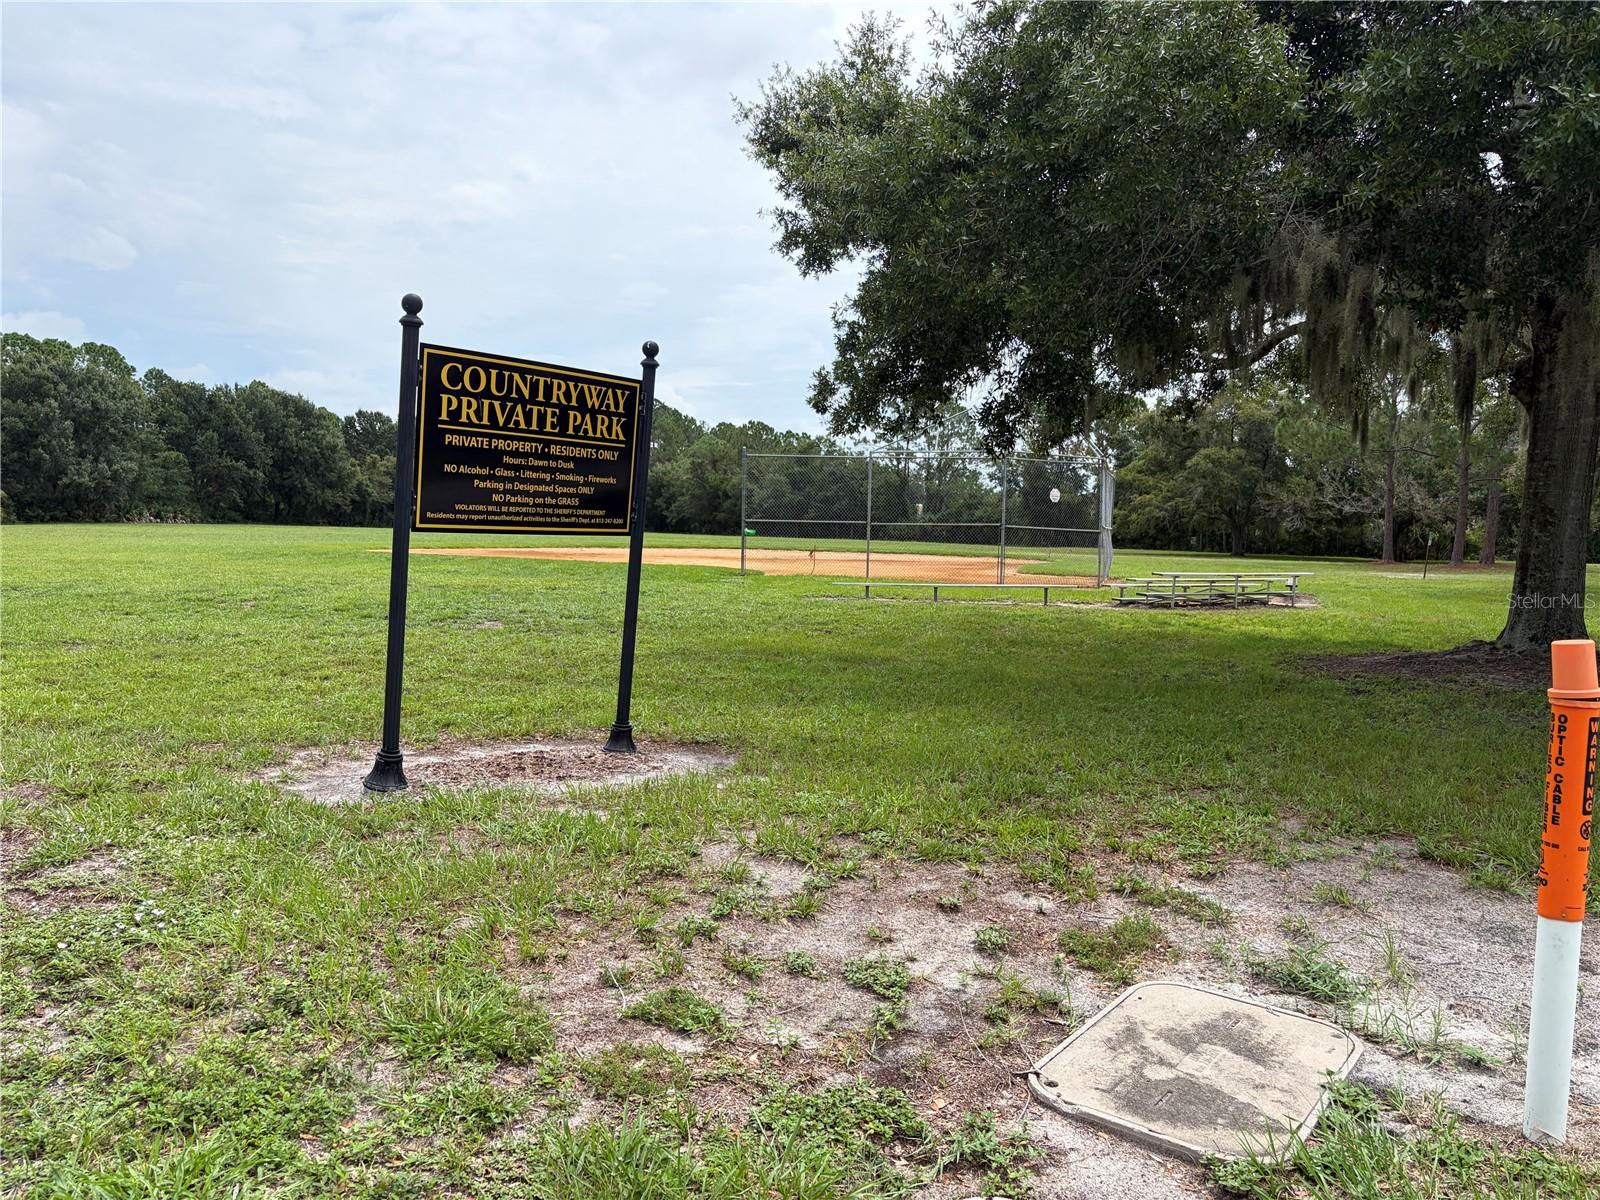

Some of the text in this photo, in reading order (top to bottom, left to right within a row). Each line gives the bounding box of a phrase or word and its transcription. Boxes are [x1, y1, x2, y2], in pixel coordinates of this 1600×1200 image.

[441, 362, 630, 413] COUNTRYWAY
[438, 393, 628, 441] PRIVATE PARK
[445, 434, 619, 461] PRIVATE PROPERTY RESIDENTS ONLY
[503, 455, 527, 465] Hours:
[528, 458, 548, 467] Dawn
[558, 460, 574, 469] Dusk
[444, 464, 617, 484] NO Alcohol Glass Littering Smoking Fireworks
[474, 480, 595, 494] Parking in Designated Spaces ONLY
[492, 494, 504, 502] NO
[506, 495, 533, 505] Parking
[545, 496, 556, 504] the
[557, 497, 579, 506] GRASS
[427, 511, 455, 519] Residents
[1552, 714, 1568, 825] OPTIC CABLE
[1585, 721, 1599, 812] WARNING
